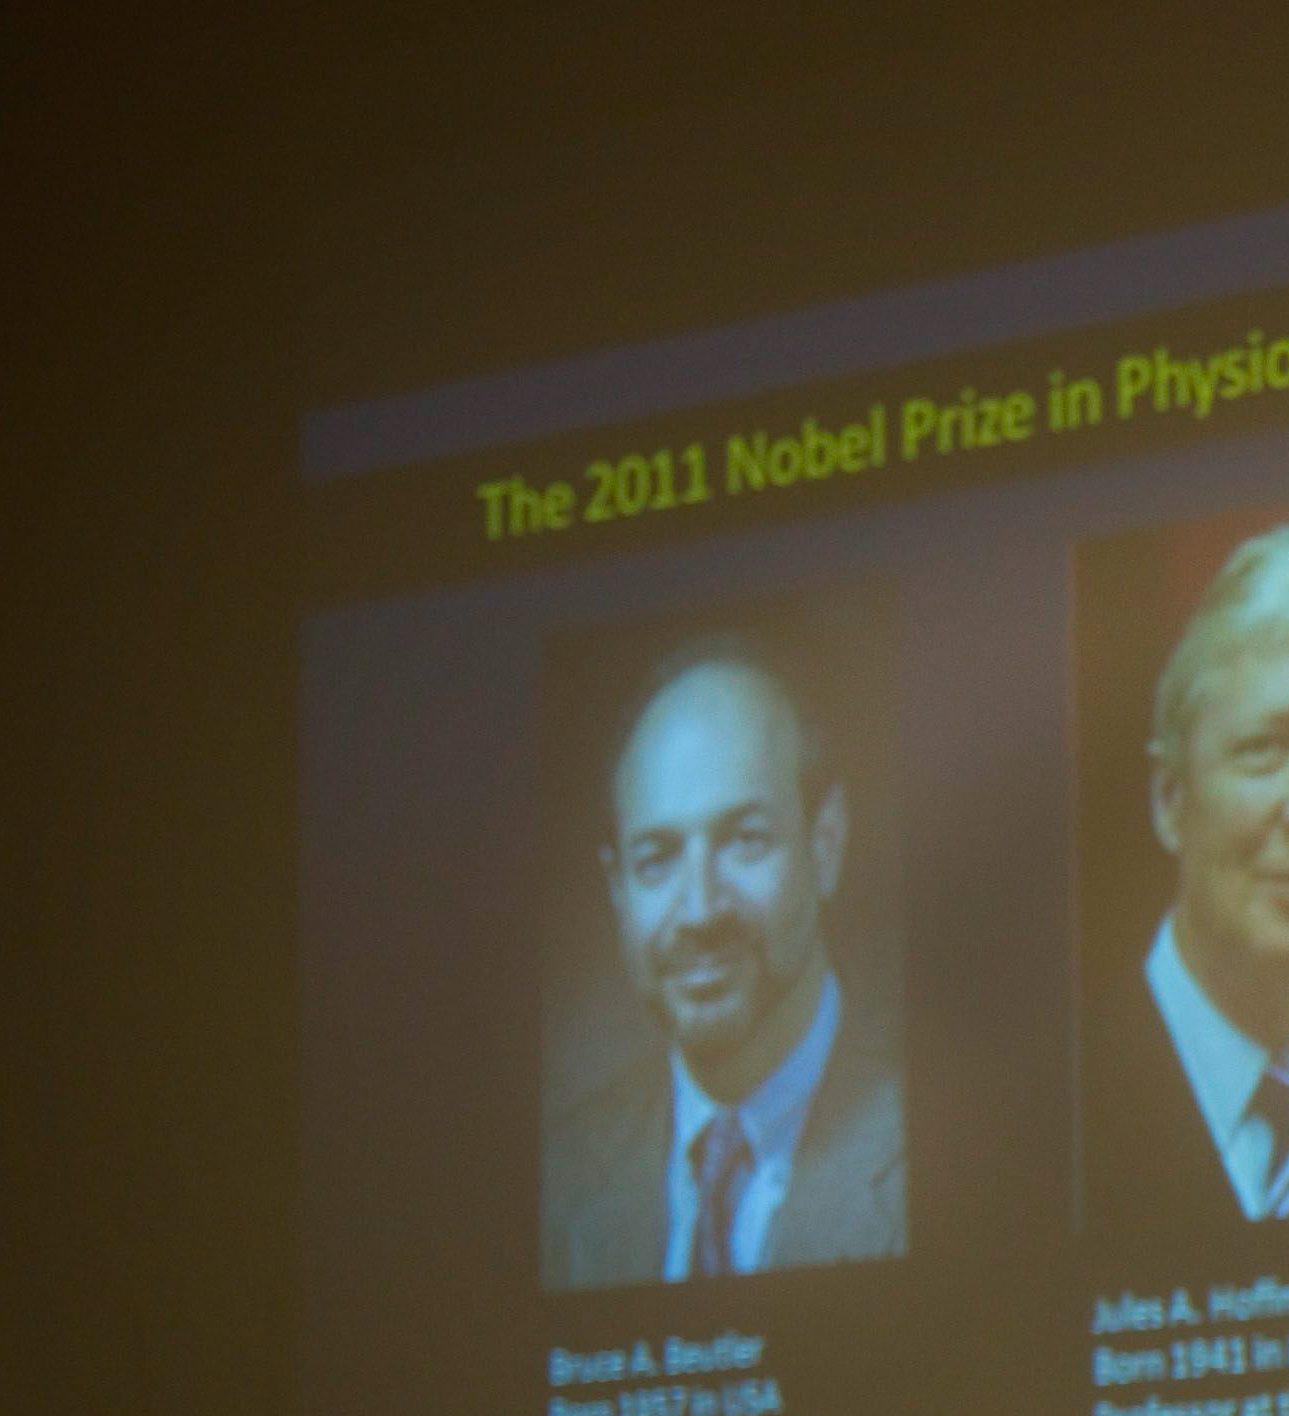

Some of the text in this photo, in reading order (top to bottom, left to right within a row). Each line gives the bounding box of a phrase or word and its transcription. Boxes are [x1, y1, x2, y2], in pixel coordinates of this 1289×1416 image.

[476, 474, 575, 541] The
[584, 442, 711, 524] 2011
[724, 403, 886, 494] Nobel
[902, 386, 1034, 461] Prize
[1047, 370, 1101, 431] in
